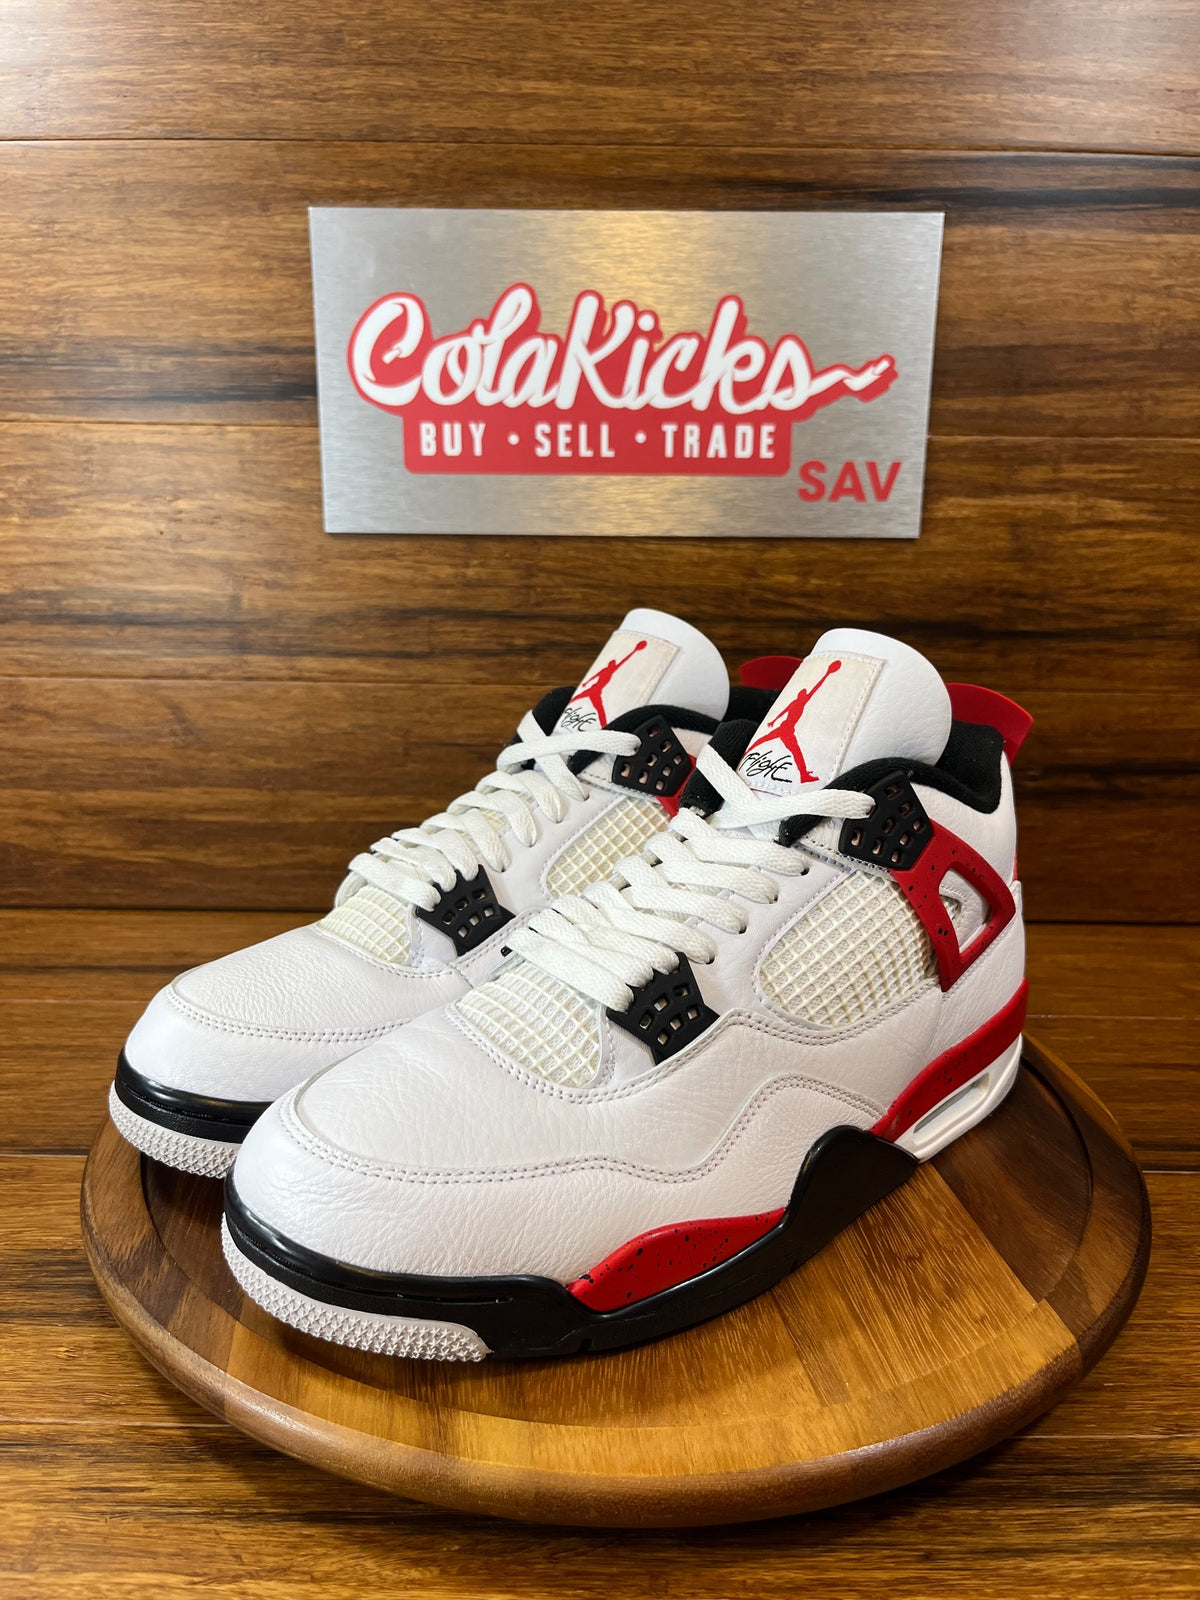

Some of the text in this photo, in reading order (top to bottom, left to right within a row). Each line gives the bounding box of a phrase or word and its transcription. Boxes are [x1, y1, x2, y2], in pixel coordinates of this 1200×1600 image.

[351, 284, 891, 414] ColaKicks
[420, 422, 776, 460] BUY SELL TRADE
[798, 460, 902, 503] SAV
[738, 750, 793, 783] Flight
